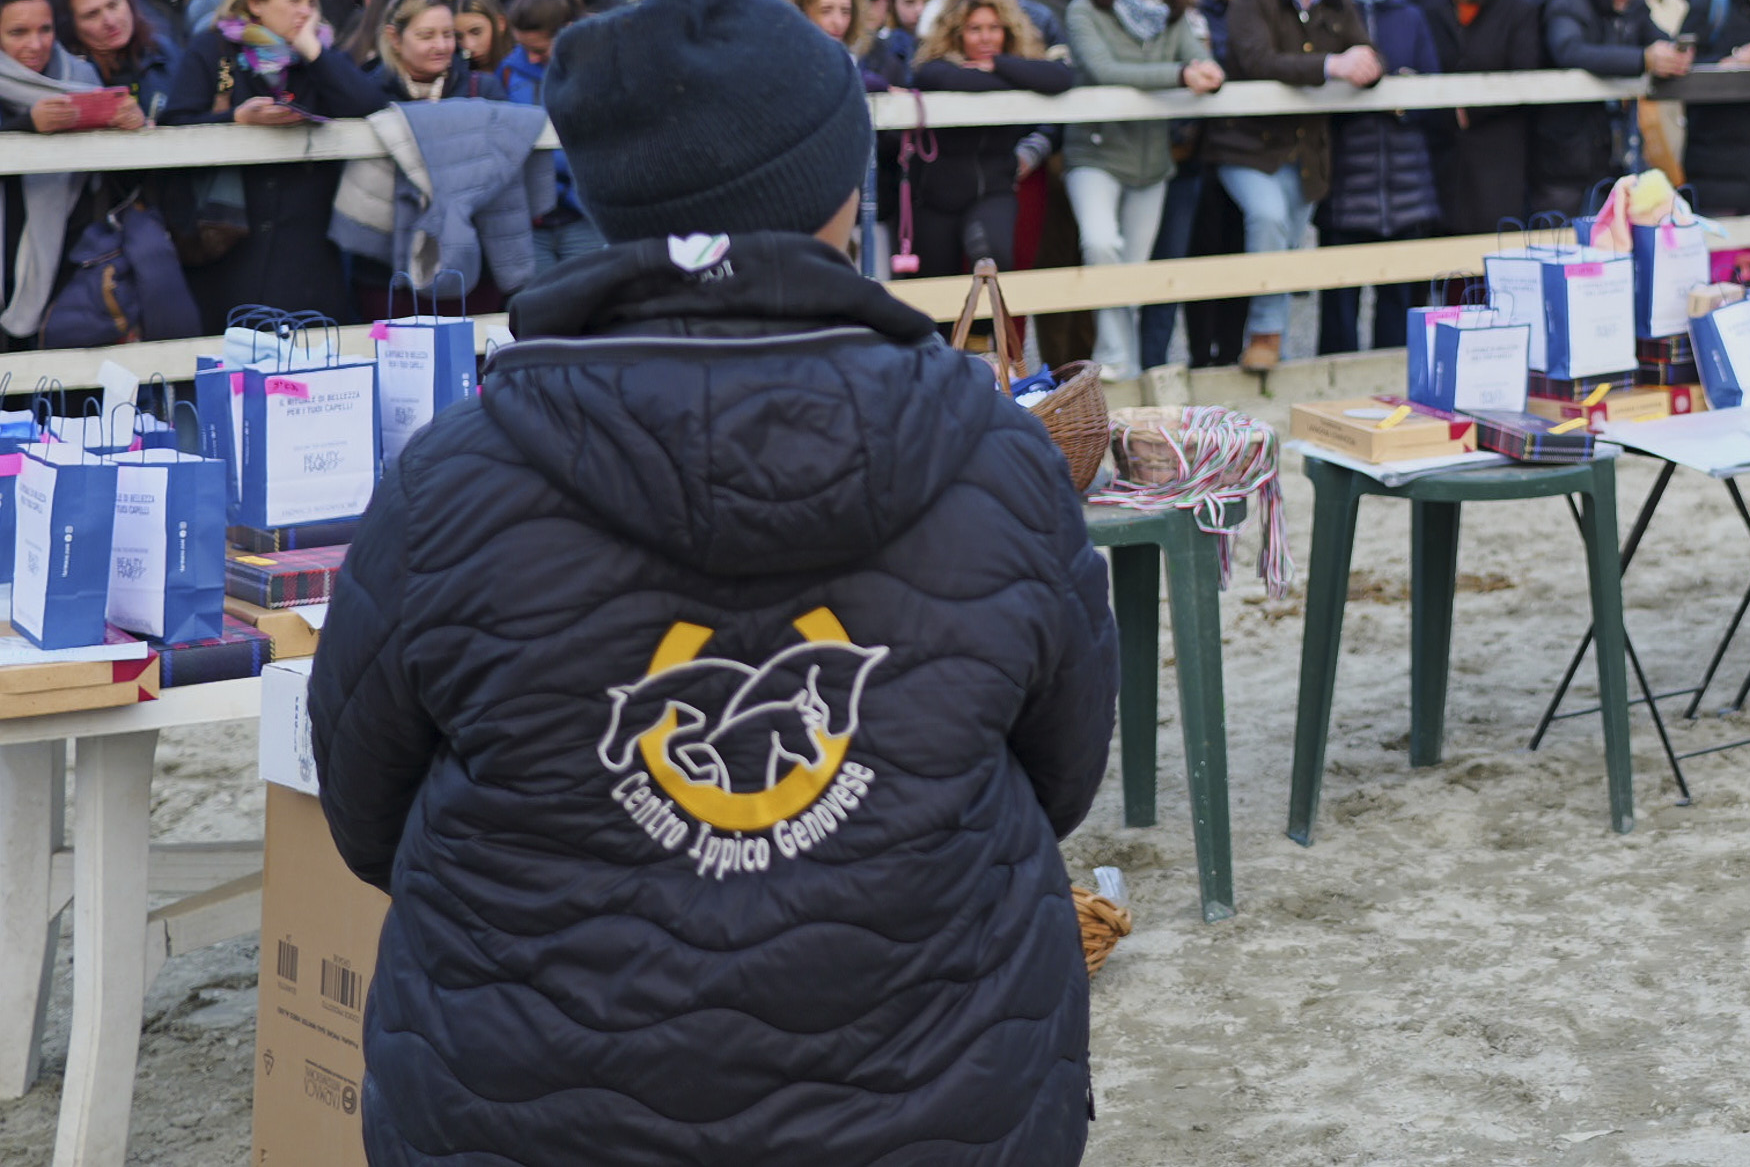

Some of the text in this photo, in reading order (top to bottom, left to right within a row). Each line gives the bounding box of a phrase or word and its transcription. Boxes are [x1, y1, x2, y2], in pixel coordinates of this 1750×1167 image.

[611, 760, 876, 880] Centro Ippico Genovese
